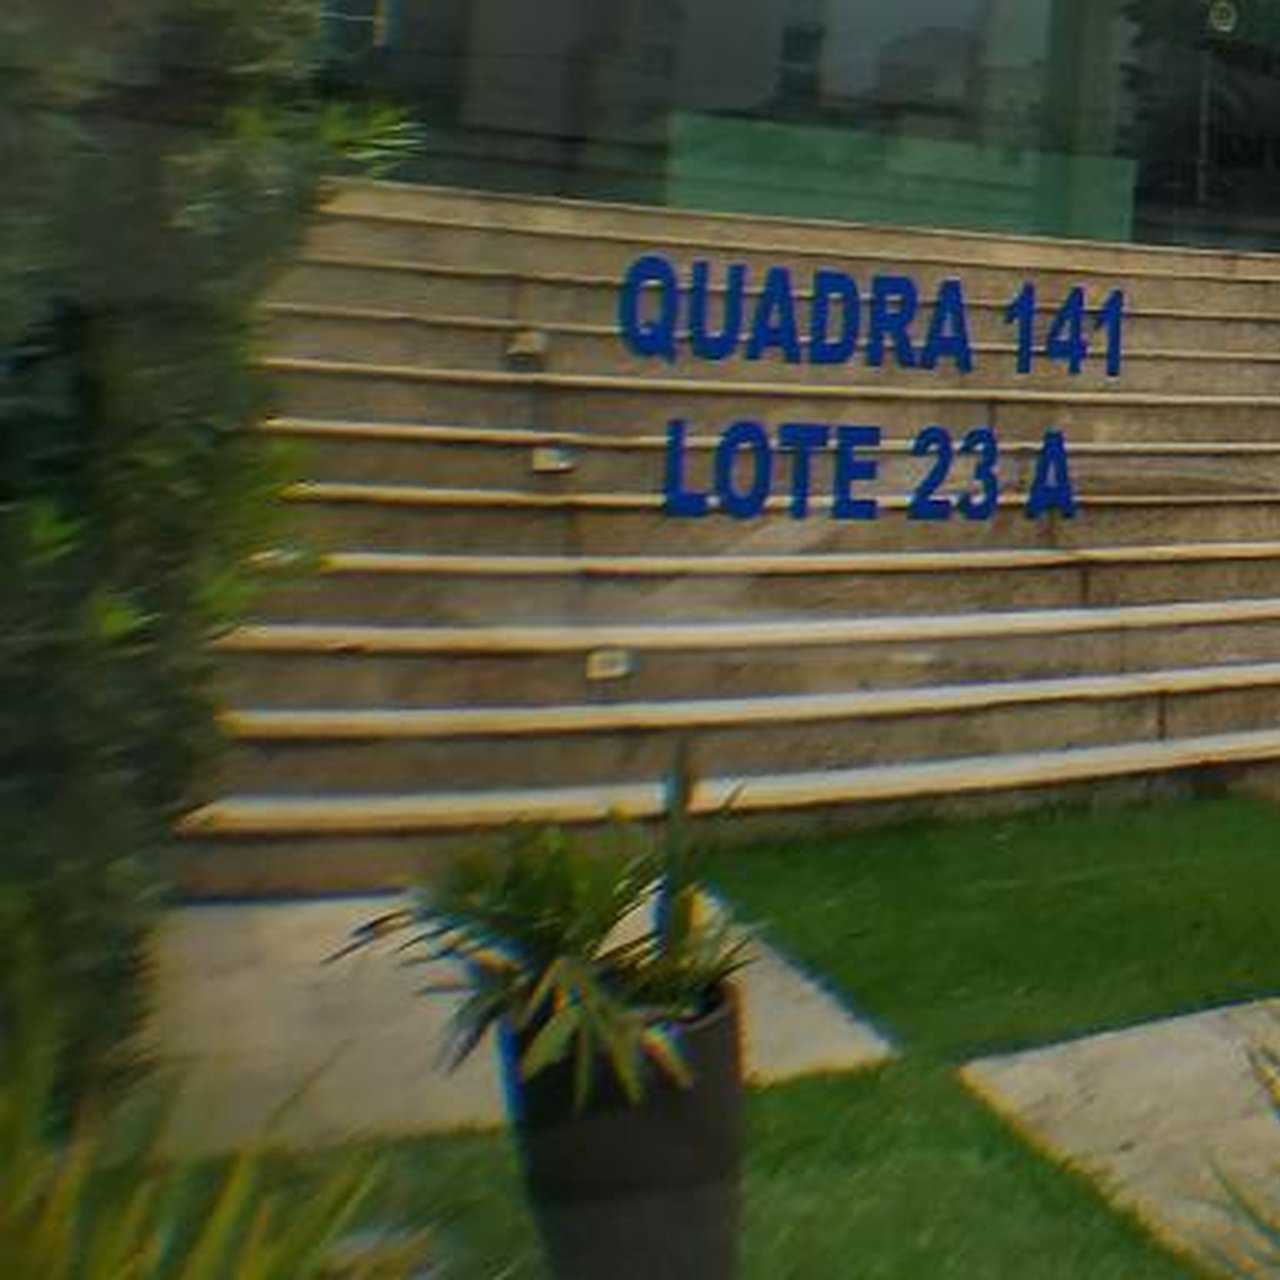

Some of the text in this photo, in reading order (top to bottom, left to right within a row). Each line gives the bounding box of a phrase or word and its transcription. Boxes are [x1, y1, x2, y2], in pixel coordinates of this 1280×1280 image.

[618, 253, 1124, 376] QUADRA 141
[662, 420, 1077, 520] LOTE 23 A
